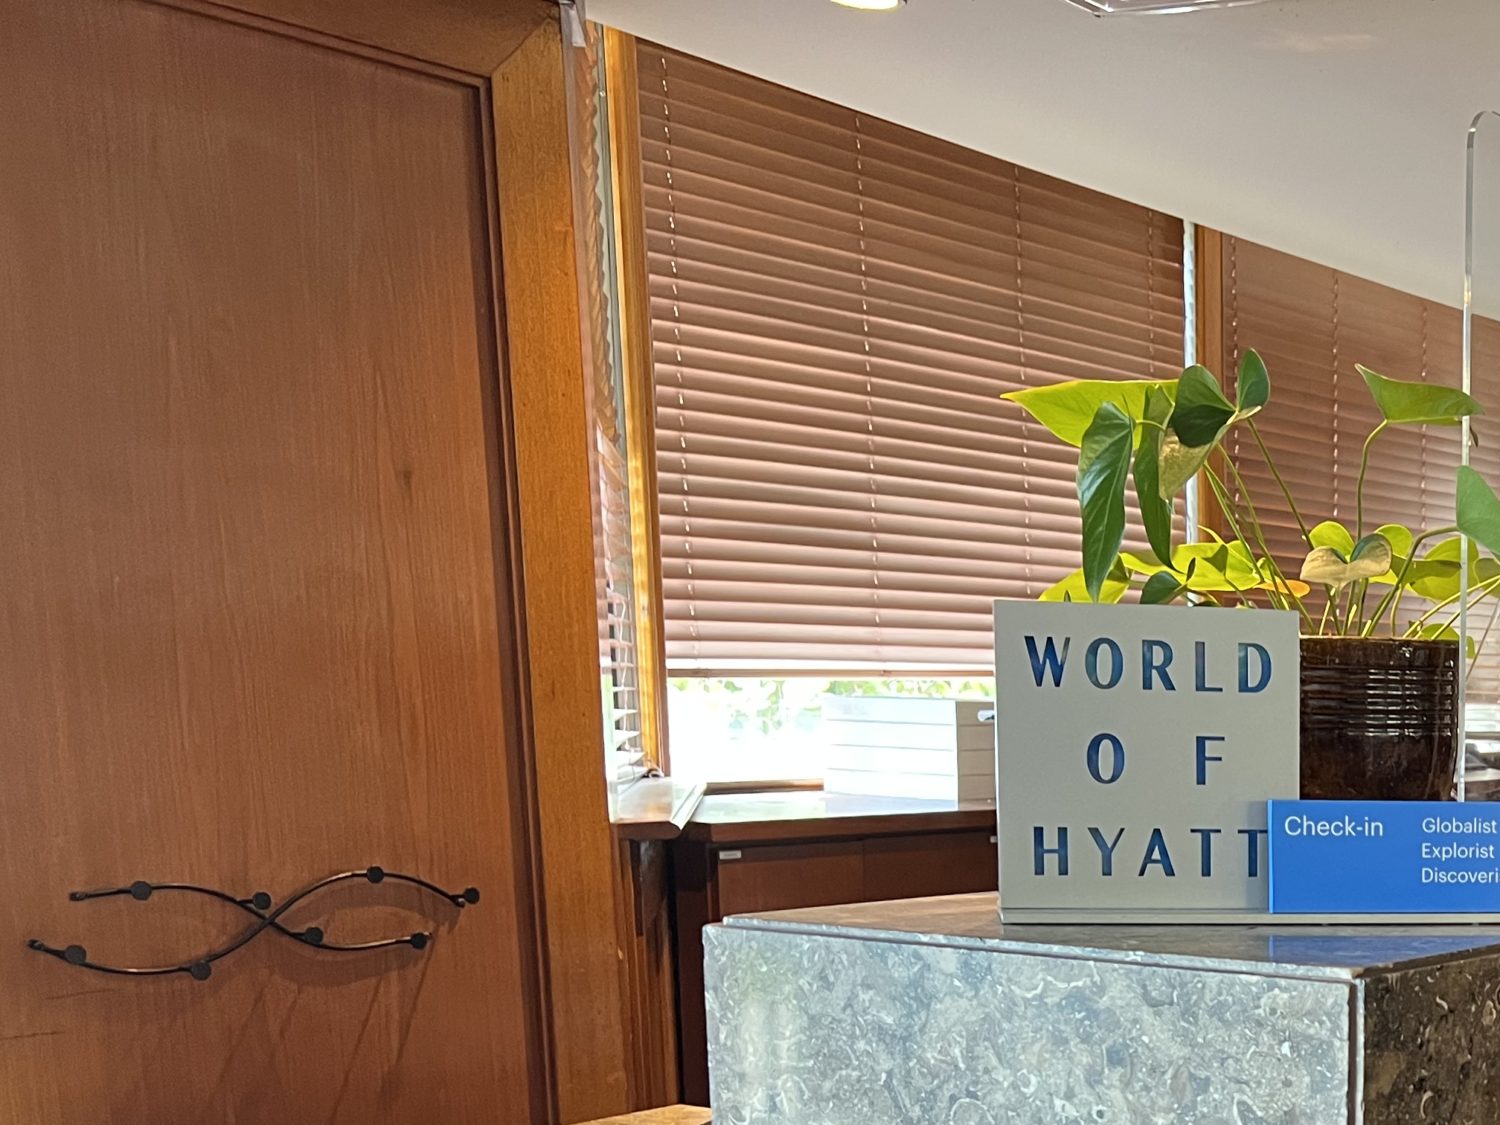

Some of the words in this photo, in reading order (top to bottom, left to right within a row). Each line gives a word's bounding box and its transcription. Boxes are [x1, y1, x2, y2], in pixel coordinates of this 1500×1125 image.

[1024, 634, 1273, 694] WORLD
[1284, 815, 1384, 837] Check-in
[1422, 816, 1497, 834] Globalist
[1032, 825, 1268, 878] HYATT
[1422, 842, 1495, 861] Explorist
